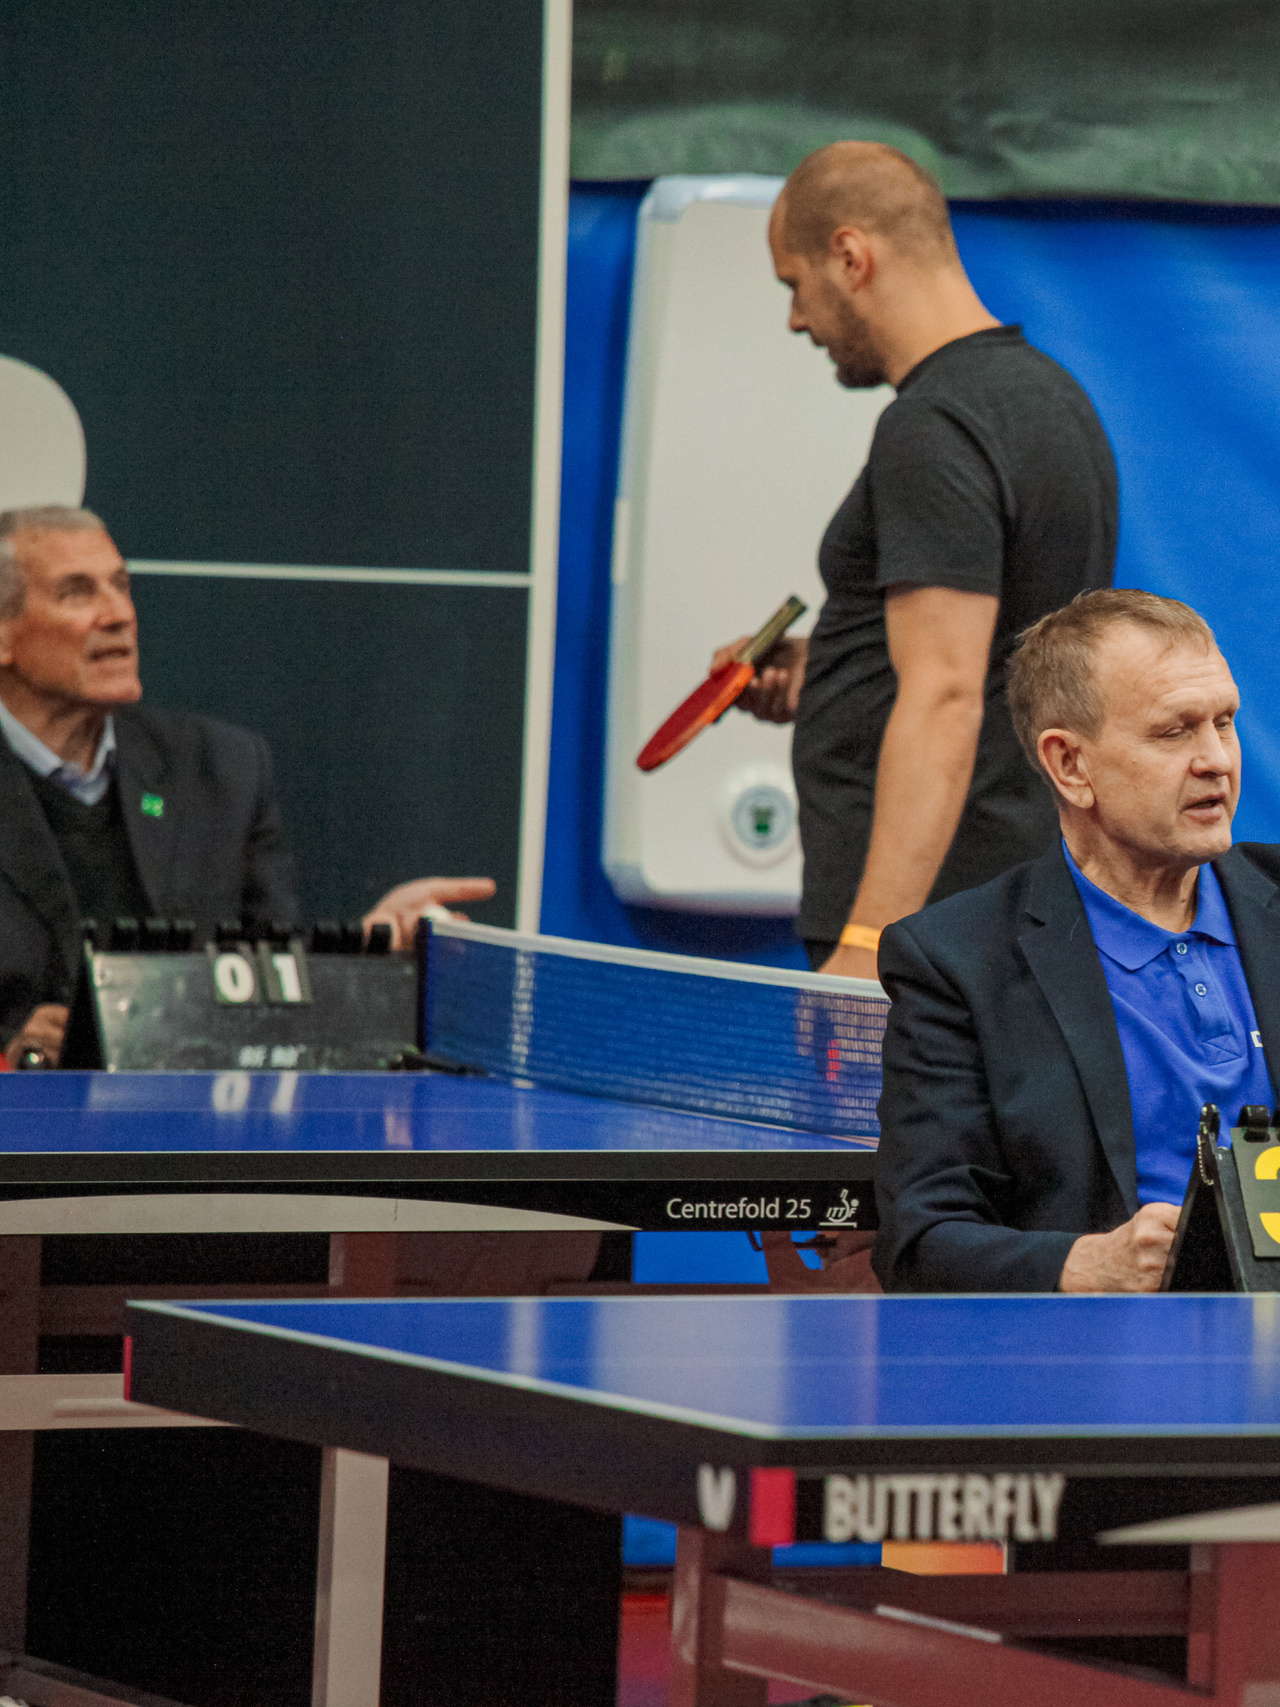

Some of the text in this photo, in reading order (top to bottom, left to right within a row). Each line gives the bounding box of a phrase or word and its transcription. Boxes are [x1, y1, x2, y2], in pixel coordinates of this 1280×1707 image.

[214, 953, 301, 1002] 0 1
[666, 1197, 811, 1219] Centrefold 25
[824, 1473, 1065, 1543] BUTTERFLY
